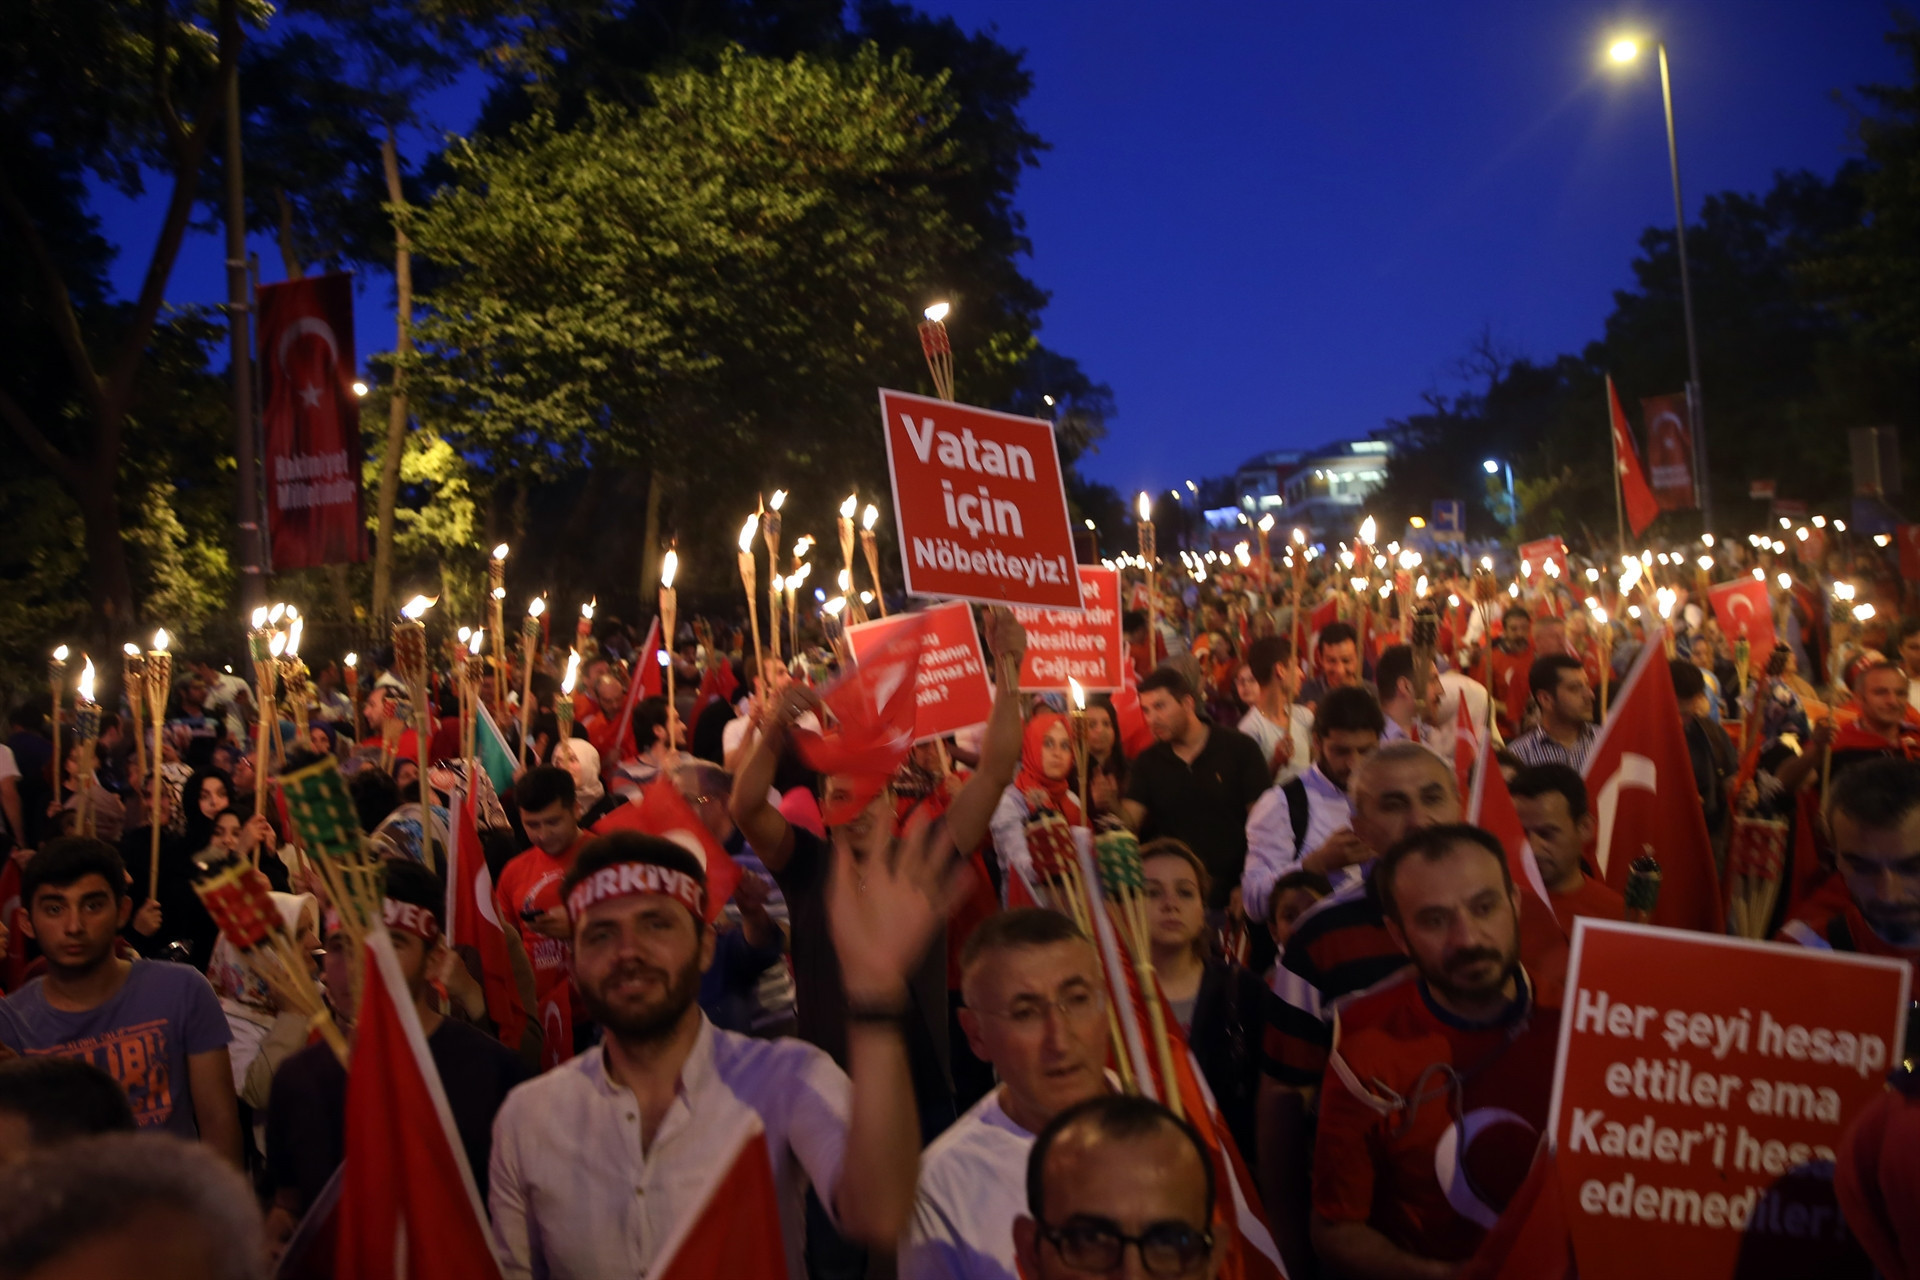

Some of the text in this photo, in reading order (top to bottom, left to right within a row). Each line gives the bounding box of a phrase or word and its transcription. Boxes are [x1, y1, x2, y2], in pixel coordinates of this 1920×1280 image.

[900, 413, 1036, 482] Vatan
[941, 478, 1024, 539] için
[912, 536, 1069, 588] Nöbetteyiz!
[1026, 629, 1107, 651] Nesillere
[1574, 988, 1886, 1080] Her şeyi hesap
[1605, 1057, 1841, 1124] ettiler ama
[1569, 1107, 1837, 1181] Kader'i hesa
